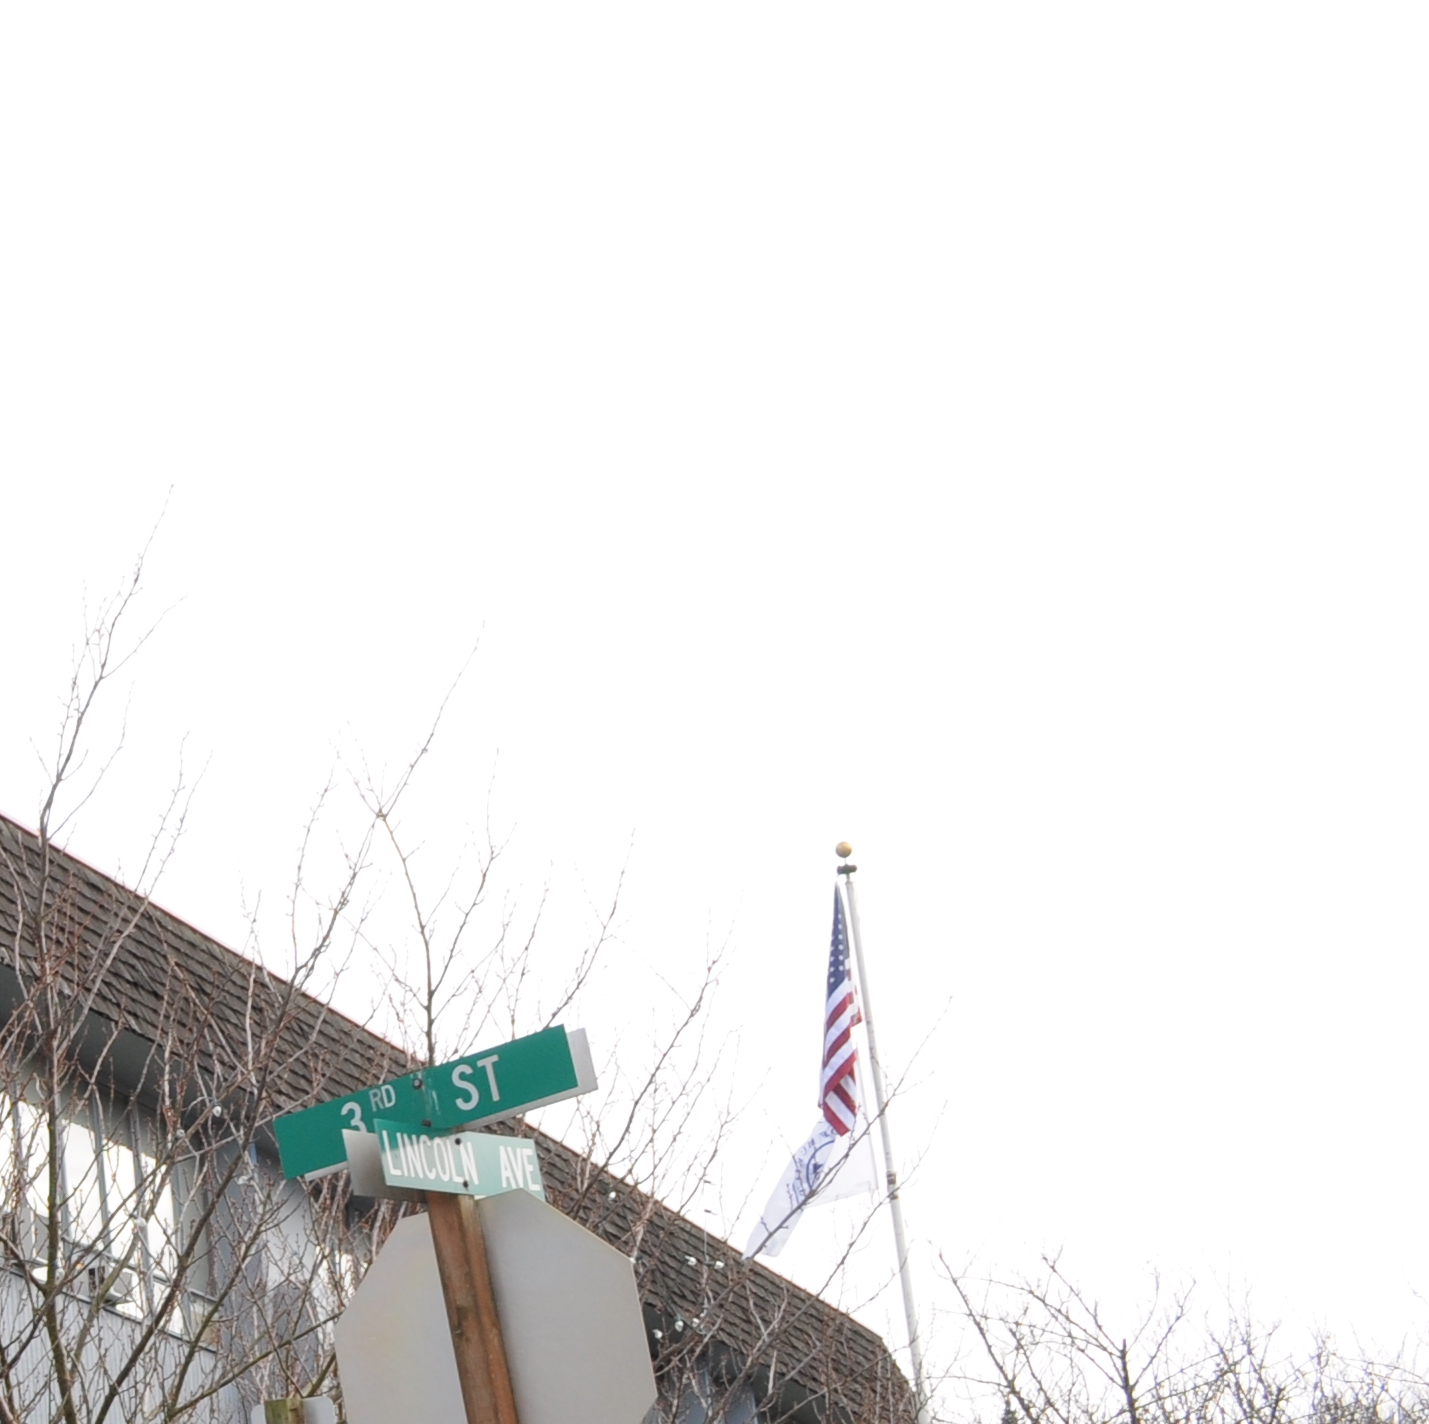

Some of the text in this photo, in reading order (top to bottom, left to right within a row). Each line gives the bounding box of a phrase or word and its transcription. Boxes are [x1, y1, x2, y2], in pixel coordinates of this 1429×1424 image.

[451, 1054, 501, 1111] ST
[382, 1129, 541, 1191] LINCOLN AVE
